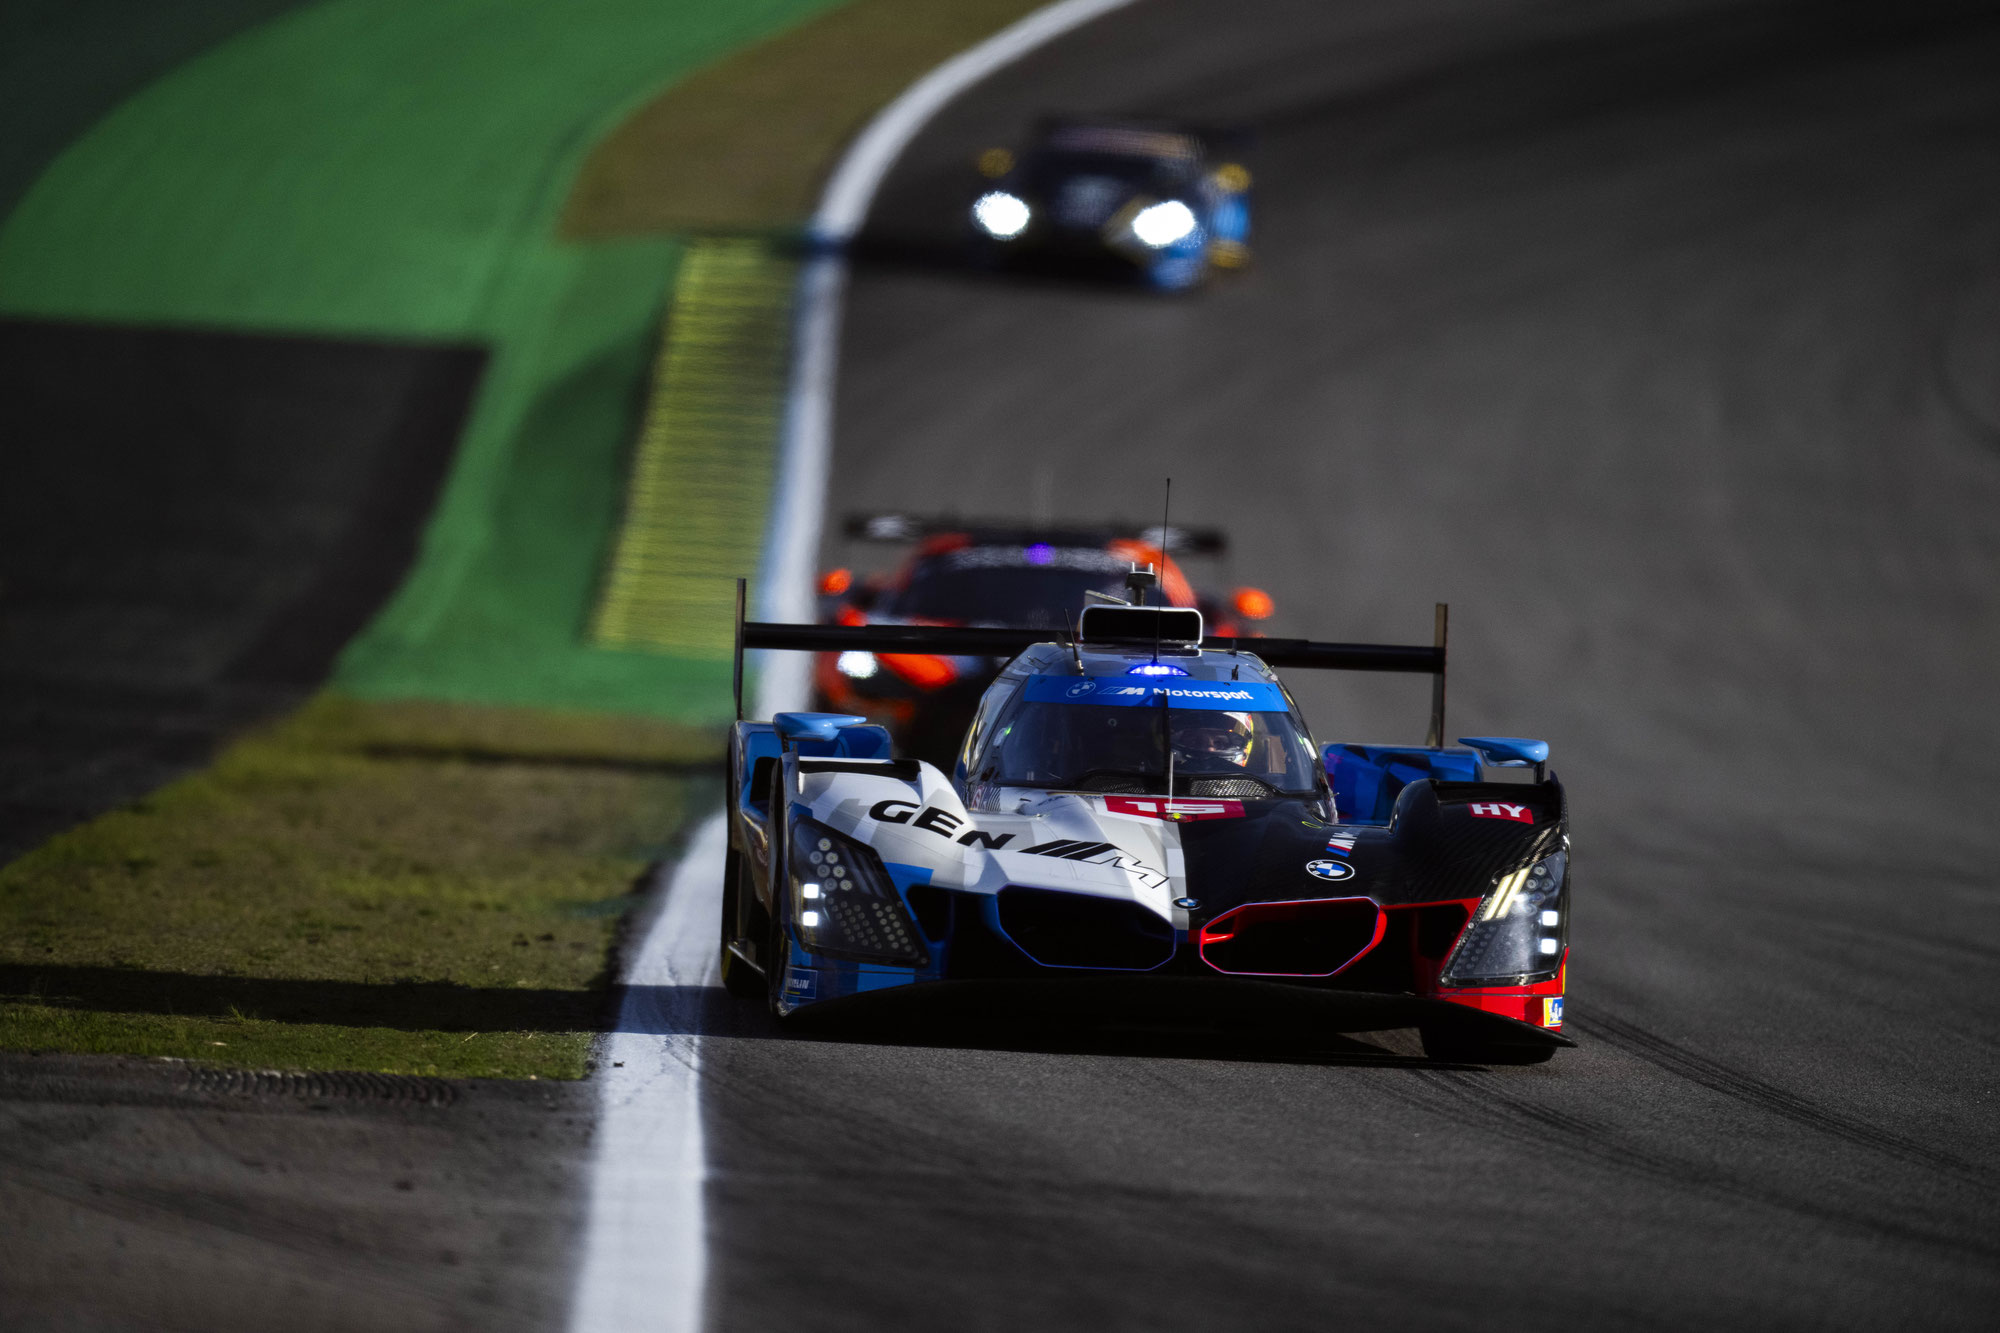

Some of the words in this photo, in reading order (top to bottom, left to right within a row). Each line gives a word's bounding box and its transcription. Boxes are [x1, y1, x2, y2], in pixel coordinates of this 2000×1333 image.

[1153, 688, 1253, 700] Motorsport
[1125, 801, 1225, 813] 15
[1472, 803, 1526, 818] HY
[869, 800, 1016, 849] GEN
